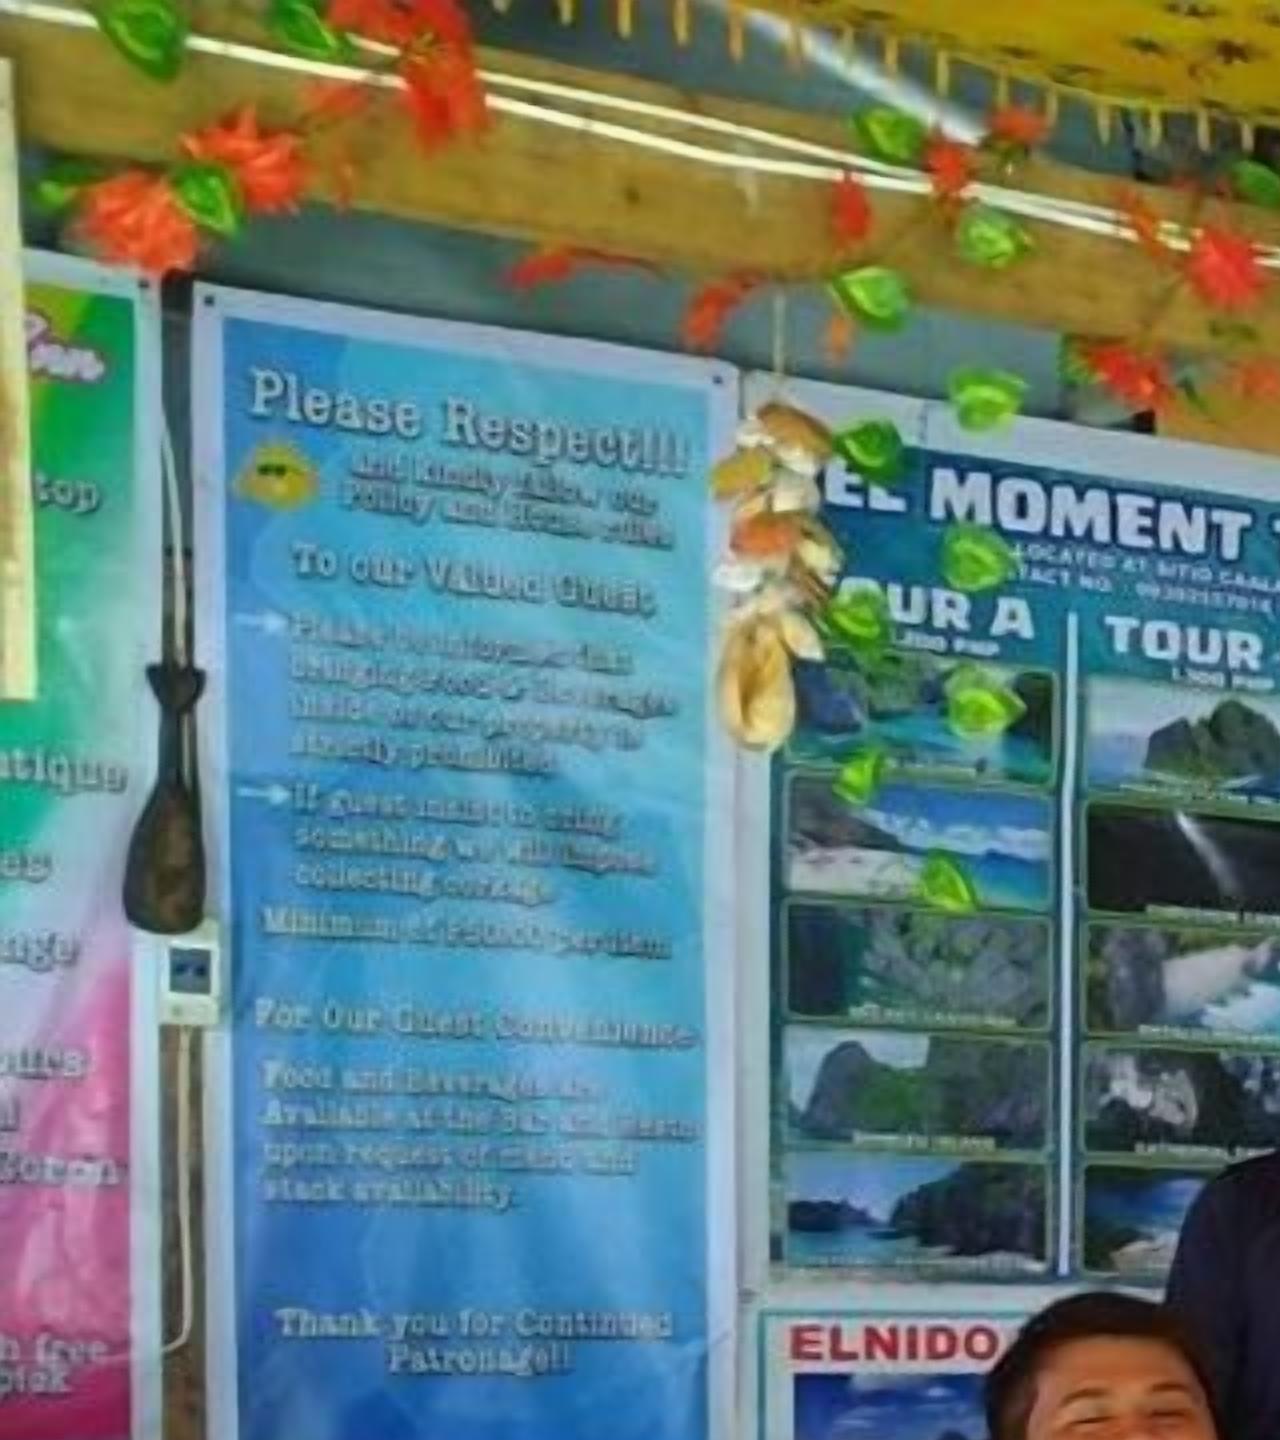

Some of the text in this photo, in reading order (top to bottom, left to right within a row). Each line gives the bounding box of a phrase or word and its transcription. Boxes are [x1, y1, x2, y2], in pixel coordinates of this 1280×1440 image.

[249, 367, 424, 440] Please
[930, 466, 1252, 562] MOMENT
[290, 539, 337, 580] To
[990, 596, 1036, 641] A
[1104, 615, 1264, 673] TOUR
[271, 1306, 674, 1347] Thank you for Continued
[789, 1323, 1000, 1362] ELNIDO
